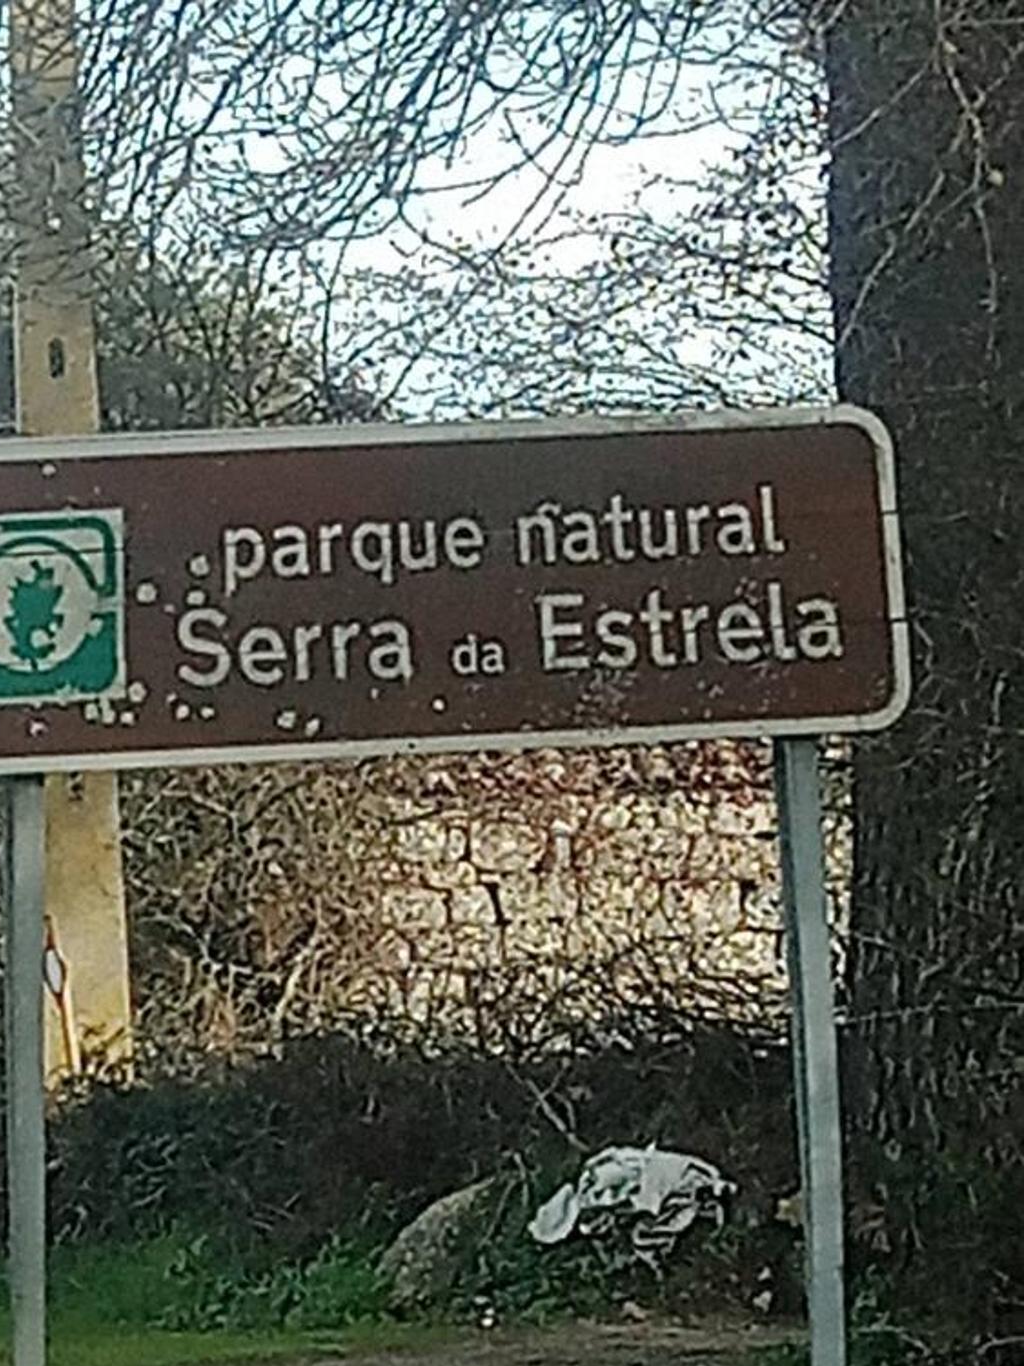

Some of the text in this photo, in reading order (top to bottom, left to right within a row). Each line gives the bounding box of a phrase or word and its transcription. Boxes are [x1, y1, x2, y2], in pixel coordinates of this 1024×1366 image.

[223, 485, 786, 597] parque natural
[177, 581, 844, 687] Serra da Estrela
